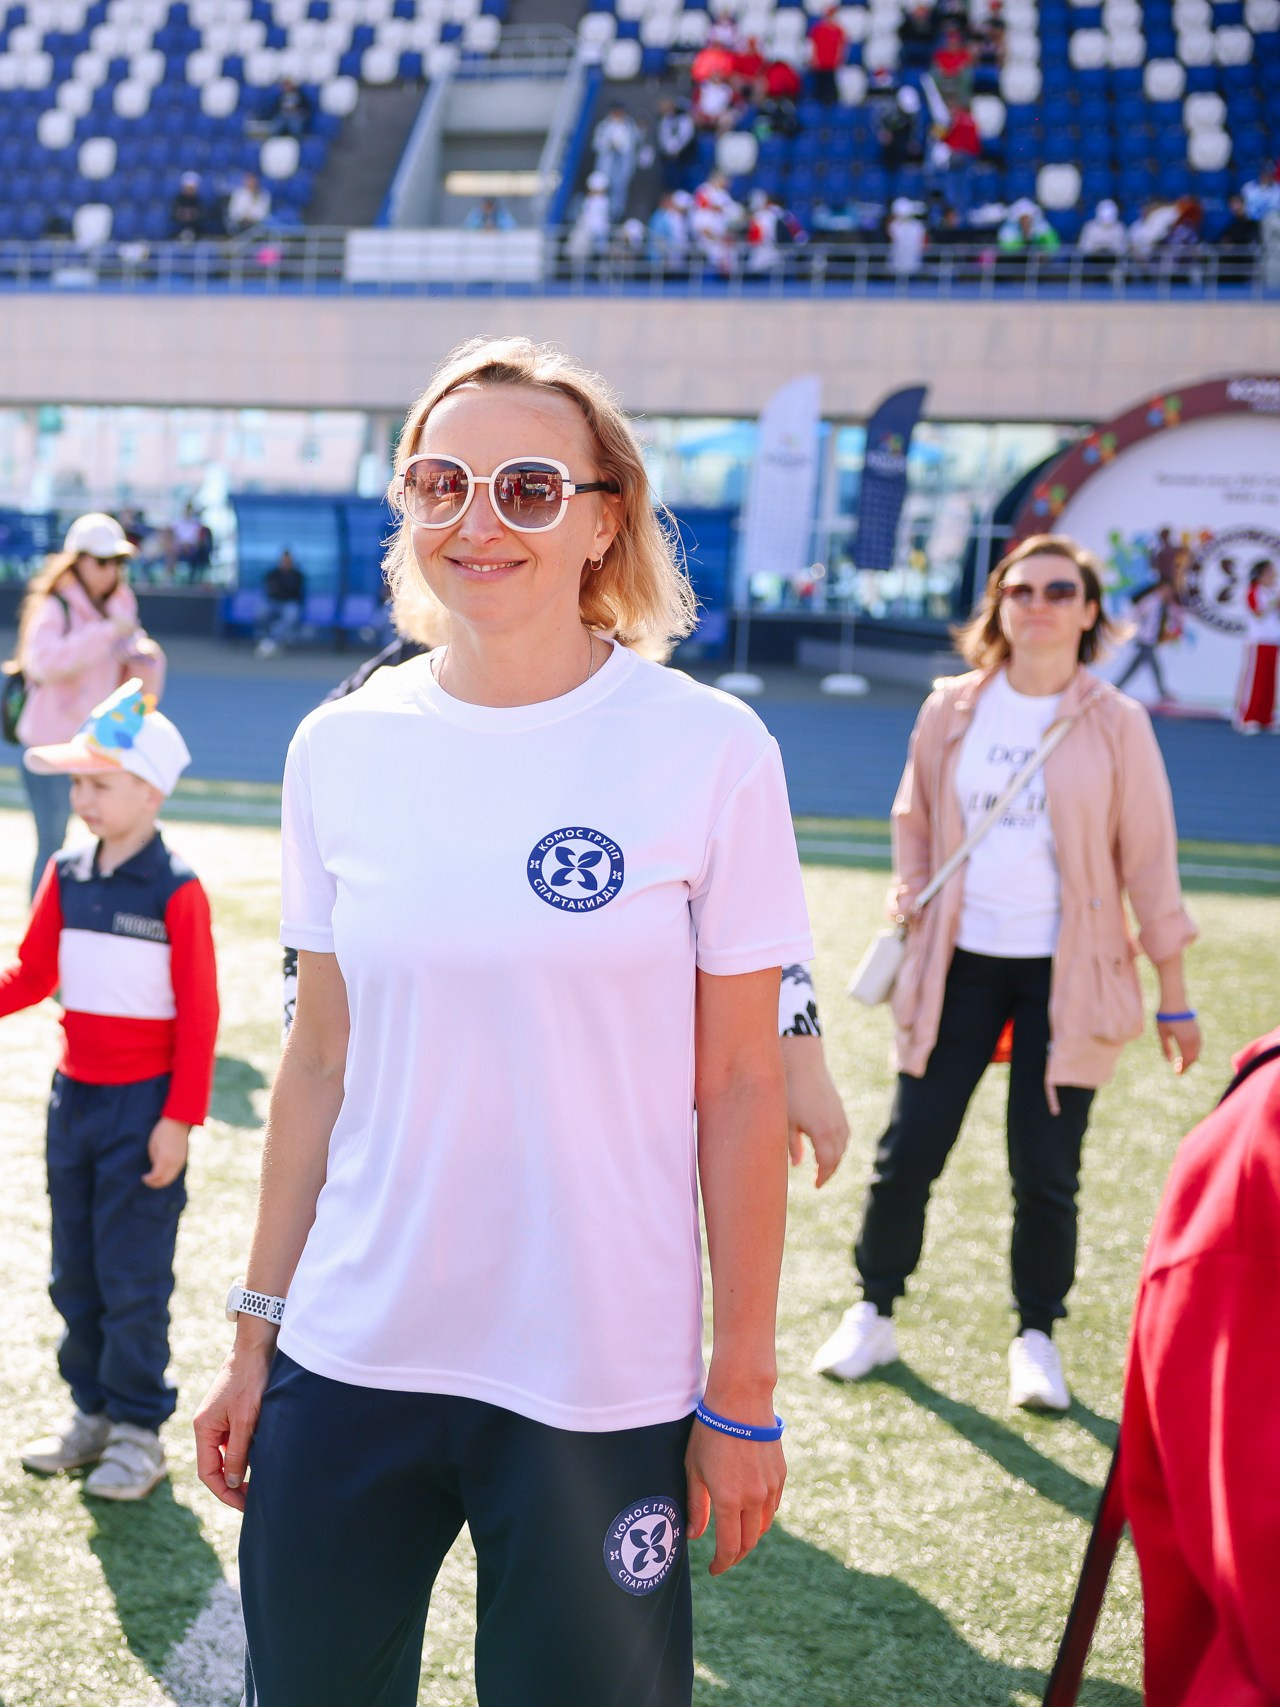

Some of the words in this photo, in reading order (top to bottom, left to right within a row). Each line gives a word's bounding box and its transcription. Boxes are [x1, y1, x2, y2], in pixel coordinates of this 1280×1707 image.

[538, 829, 584, 852] КОМОС
[587, 831, 621, 860] ГРУПП
[533, 878, 617, 909] СПАРТАКИАДА
[702, 1413, 745, 1435] СПАРТАКИАДА
[613, 1505, 650, 1539] КОМОС
[652, 1503, 676, 1522] ГРУПП
[618, 1546, 677, 1589] СПАРТАКИАДА
